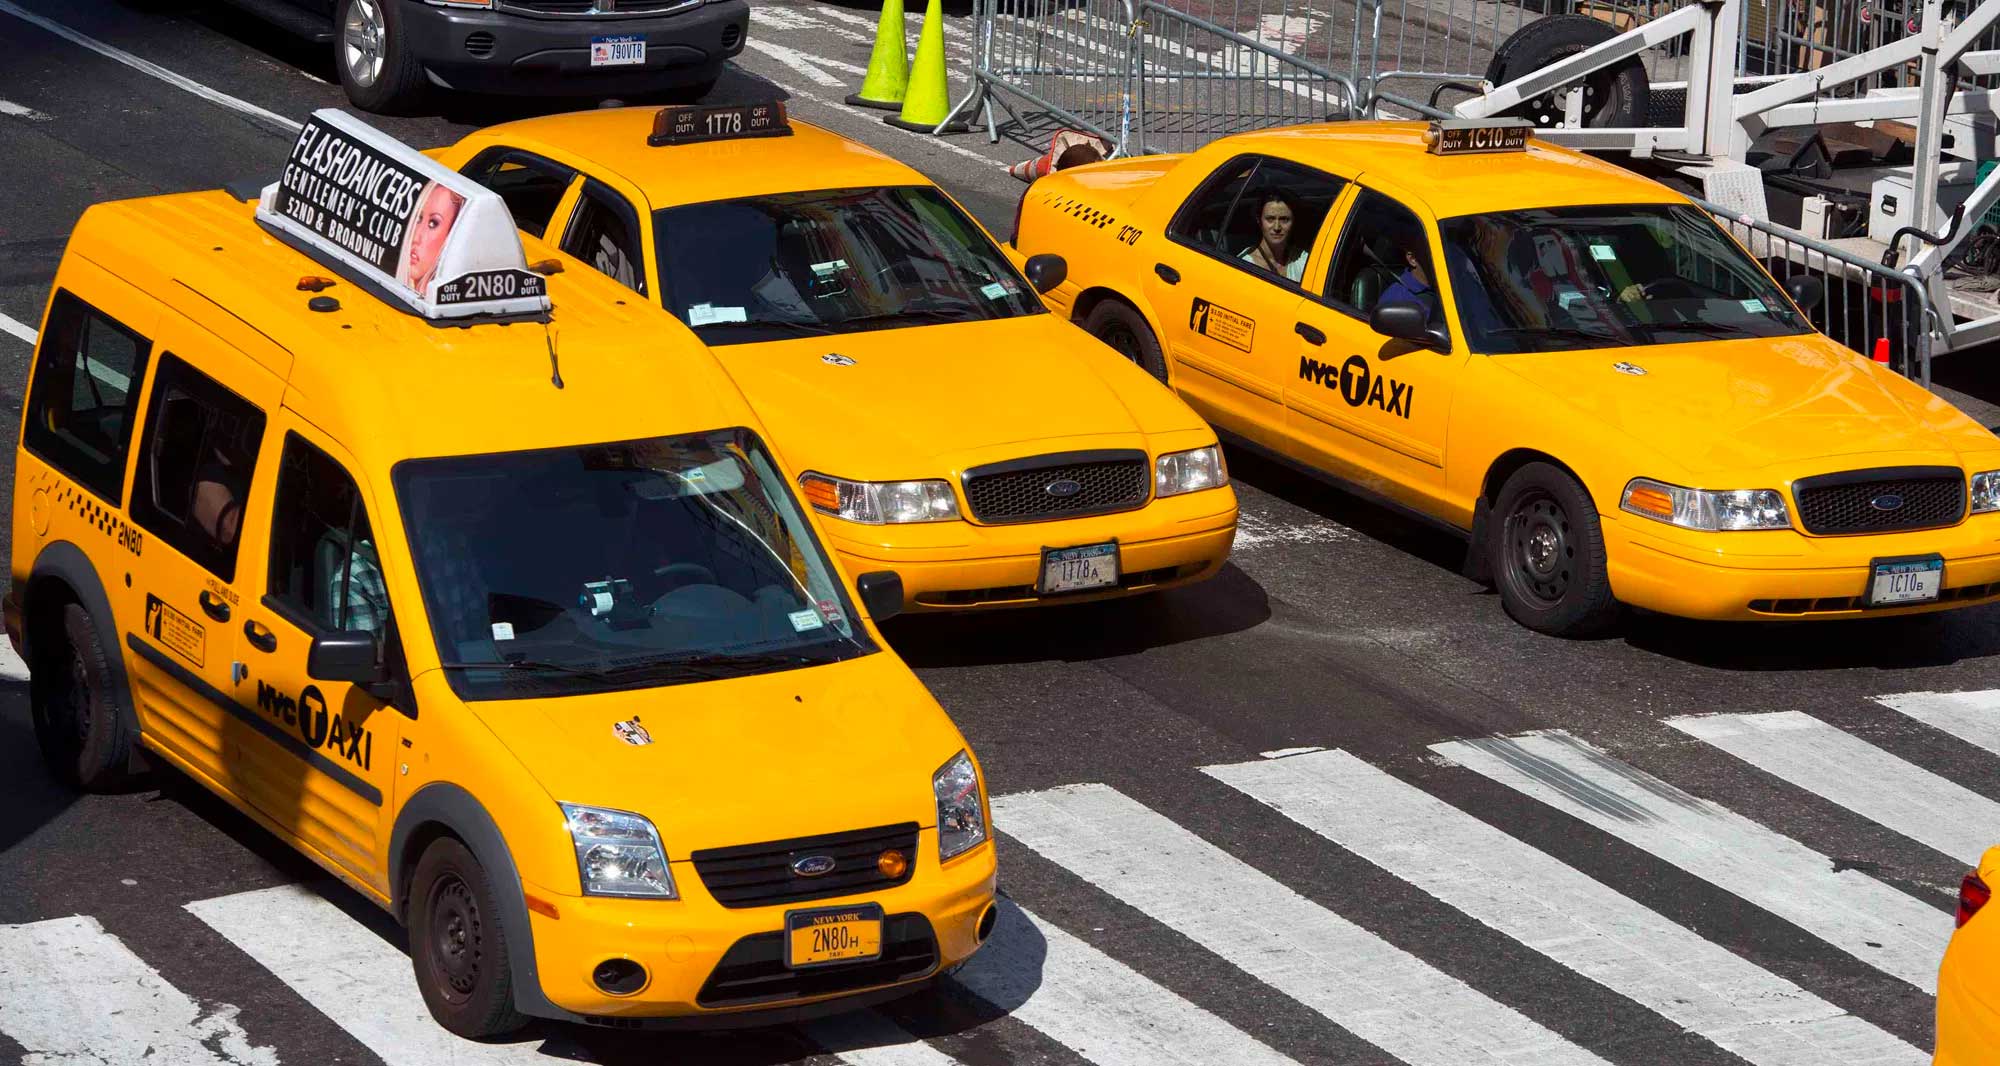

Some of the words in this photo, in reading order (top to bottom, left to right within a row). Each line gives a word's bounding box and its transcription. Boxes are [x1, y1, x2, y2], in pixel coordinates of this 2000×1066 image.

[611, 44, 642, 60] 790VTR
[678, 113, 693, 123] OFF
[752, 107, 767, 117] OFF
[675, 123, 695, 133] DUTY
[705, 112, 742, 134] 1T78
[751, 117, 770, 127] DUTY
[1448, 130, 1461, 138] OFF
[1468, 127, 1504, 149] 1C10
[1509, 128, 1523, 136] OFF
[1442, 139, 1462, 148] DUTY
[1505, 138, 1524, 147] DUTY
[292, 123, 422, 220] FLASHDANCERS
[283, 164, 368, 228] GENTLEMEN'S
[369, 207, 403, 246] CLUB
[287, 195, 314, 228] 52ND
[315, 214, 324, 231] &
[329, 217, 385, 265] BROADWAY
[1116, 225, 1143, 246] 1C10
[444, 284, 458, 294] OFF
[464, 274, 516, 299] 2N80
[523, 277, 538, 287] OFF
[441, 292, 461, 302] DUTY
[521, 285, 540, 296] DUTY
[1300, 356, 1338, 390] NYC
[1340, 355, 1413, 419] TAXI
[118, 522, 143, 557] 2N80
[1062, 559, 1098, 581] 1T78A
[1890, 573, 1923, 593] 1C10B
[257, 679, 297, 727] NYC
[299, 685, 372, 772] TAXI
[804, 862, 828, 873] Ford
[812, 916, 836, 925] NEW
[837, 912, 861, 921] YORK
[813, 926, 859, 953] 2N80H
